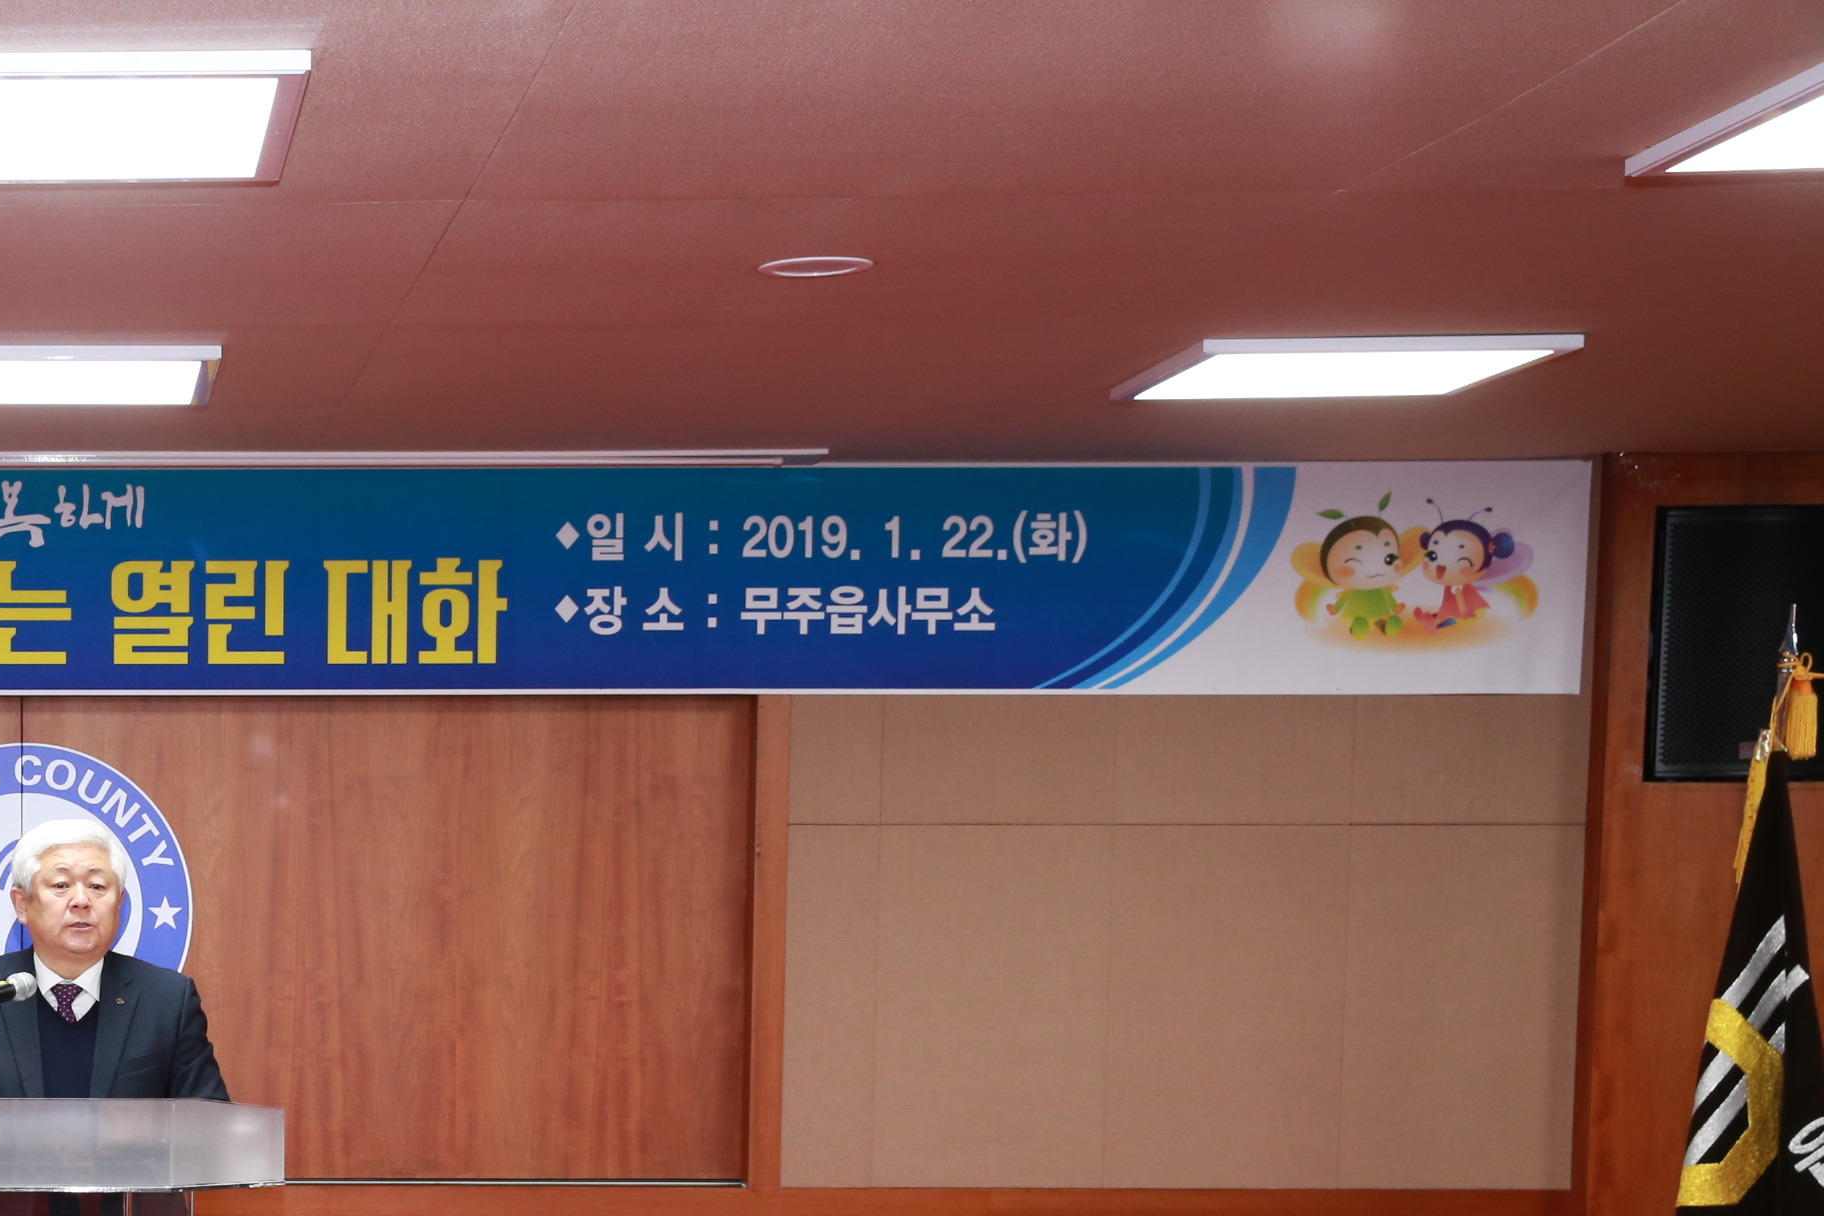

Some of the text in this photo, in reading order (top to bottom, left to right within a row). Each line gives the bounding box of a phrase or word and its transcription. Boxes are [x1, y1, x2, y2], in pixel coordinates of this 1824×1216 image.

[742, 515, 861, 561] 2019.
[885, 516, 921, 561] 1.
[942, 510, 1087, 564] 22.(화)
[112, 560, 289, 665] 열린
[323, 557, 508, 665] 대화
[740, 585, 996, 635] 무주읍사무소
[14, 754, 175, 868] COUNTY
